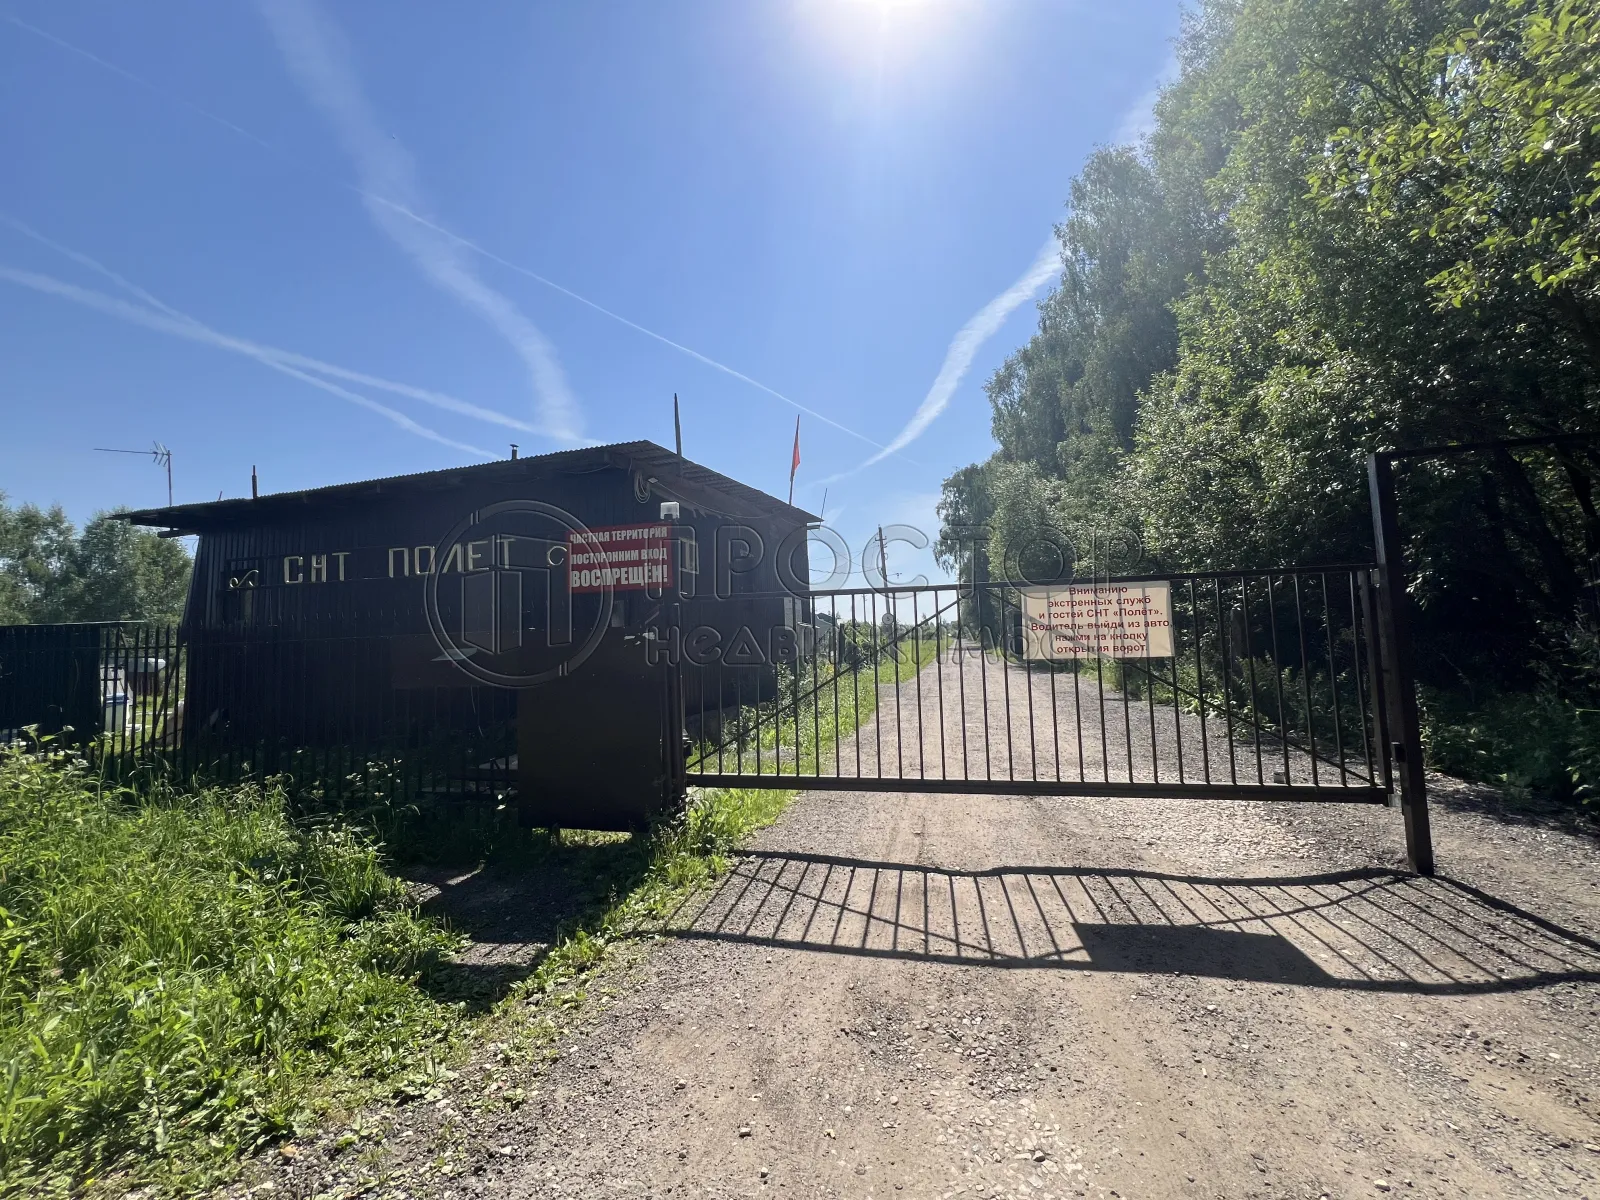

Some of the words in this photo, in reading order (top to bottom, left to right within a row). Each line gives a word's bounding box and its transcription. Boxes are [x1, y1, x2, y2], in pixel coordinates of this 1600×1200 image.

[570, 531, 610, 544] ЧАСТНАЯ
[611, 527, 668, 541] ТЕРРИТОРИЯ
[284, 552, 351, 584] СНТ
[388, 538, 516, 578] ПОЛЕТ
[570, 549, 639, 564] ПОСТОРОННИМ
[641, 548, 668, 561] ВХОД
[570, 562, 668, 588] ВОСПРЕЩЁН!
[1069, 586, 1128, 596] Вниманию
[1048, 598, 1113, 608] экстренных
[1116, 595, 1151, 606] служб
[1048, 609, 1083, 619] гостей
[1086, 608, 1110, 618] СНТ
[1031, 622, 1084, 632] Водитель
[1087, 620, 1124, 630] выйди
[1127, 621, 1141, 629] из
[1055, 633, 1091, 642] нажми
[1093, 633, 1107, 641] на
[1109, 632, 1149, 643] кнопку
[1056, 645, 1109, 655] открытия
